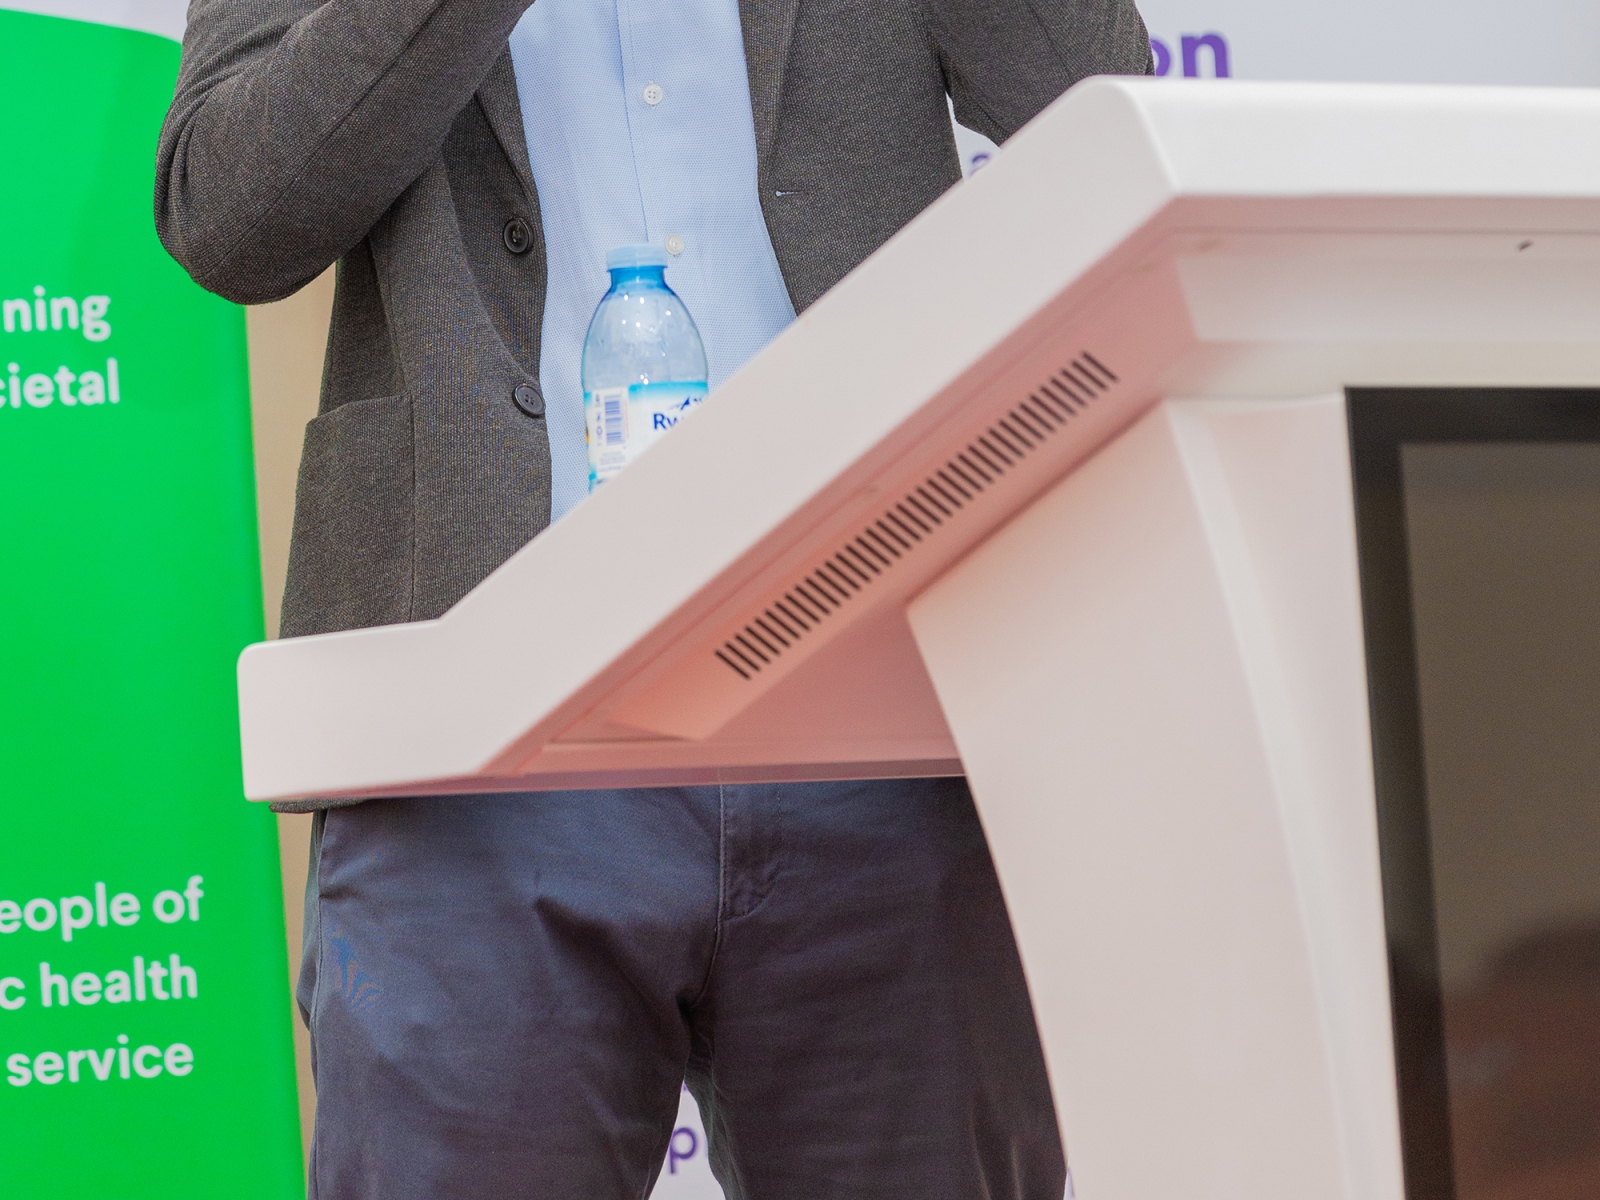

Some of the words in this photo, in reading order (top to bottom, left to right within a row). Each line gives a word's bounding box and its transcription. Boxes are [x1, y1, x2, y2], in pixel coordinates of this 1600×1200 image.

[2, 285, 112, 343] ning
[0, 357, 121, 409] ietal
[153, 875, 205, 924] of
[40, 953, 199, 1008] health
[6, 1034, 195, 1088] service
